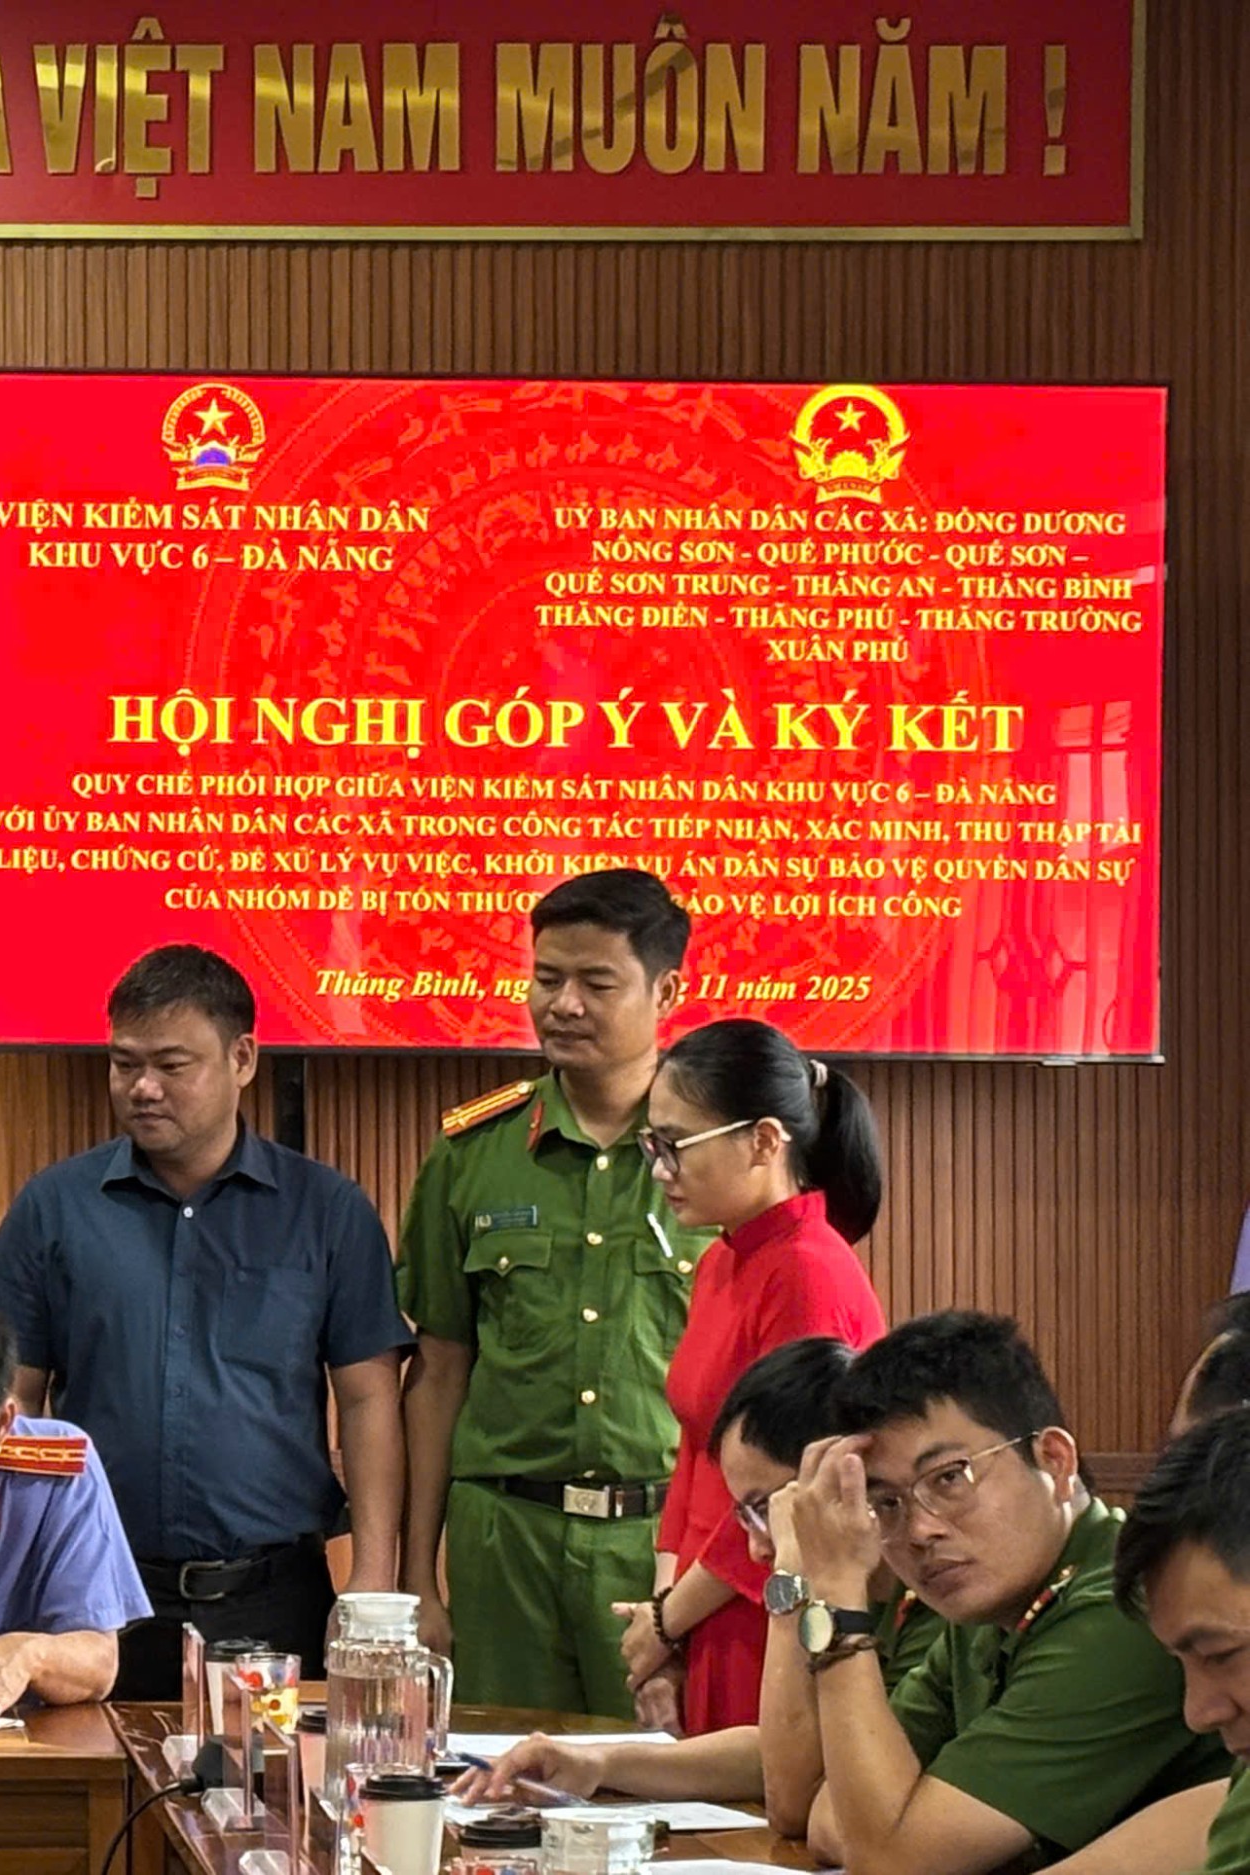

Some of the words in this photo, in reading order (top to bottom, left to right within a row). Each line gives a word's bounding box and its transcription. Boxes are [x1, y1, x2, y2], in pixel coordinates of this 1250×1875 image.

[33, 17, 225, 199] VIỆT
[254, 43, 460, 174] NAM
[496, 14, 766, 175] MUÔN
[797, 17, 1008, 176] NĂM
[1043, 44, 1068, 176] !
[182, 497, 247, 530] SÁT
[254, 499, 350, 531] NHÂN
[359, 500, 430, 533] DÂN
[599, 507, 657, 530] BAN
[663, 502, 743, 530] NHÂN
[750, 503, 808, 531] DÂN
[814, 504, 874, 532] CÁC
[880, 506, 927, 532] XÃ:
[1023, 510, 1126, 535] DƯƠNG
[29, 542, 101, 568] KHU
[110, 540, 183, 575] VỰC
[192, 544, 209, 569] 6
[242, 544, 288, 570] ĐÀ
[592, 533, 673, 562] NÔNG
[679, 540, 735, 563] SƠN
[1010, 544, 1067, 566] SƠN
[610, 571, 666, 594] SƠN
[671, 573, 771, 596] TRUNG
[792, 570, 892, 597] THĂNG
[896, 575, 936, 597] AN
[957, 572, 1057, 599] THĂNG
[1064, 572, 1132, 599] BÌNH
[535, 600, 635, 627] THĂNG
[729, 602, 831, 629] THĂNG
[837, 602, 894, 630] PHÚ
[915, 604, 1015, 631] THĂNG
[767, 633, 845, 662] XUÂN
[852, 634, 908, 663] PHÚ
[109, 688, 235, 757] HỘI
[252, 697, 426, 759] NGHỊ
[444, 685, 585, 748] GÓP
[598, 687, 645, 748] Ý
[660, 688, 754, 750] VÀ
[772, 688, 869, 751] KÝ
[887, 690, 1024, 753] KẾT
[72, 773, 130, 799] QUY
[274, 775, 331, 802] HỢP
[411, 774, 475, 803] VIỆN
[561, 773, 614, 800] SÁT
[619, 773, 695, 801] NHÂN
[702, 774, 758, 801] DÂN
[765, 780, 825, 803] KHU
[831, 780, 891, 808] VỰC
[895, 782, 911, 804] 6
[936, 777, 974, 804] ĐÀ
[86, 812, 140, 832] BAN
[148, 806, 224, 833] NHÂN
[231, 807, 287, 834] DÂN
[293, 808, 351, 835] CÁC
[357, 810, 395, 835] XÃ
[400, 815, 497, 836] TRONG
[503, 810, 582, 838] CÔNG
[587, 811, 644, 838] TÁC
[715, 816, 800, 845] NHẬN,
[805, 814, 862, 841] XÁC
[869, 820, 951, 844] MINH,
[955, 820, 1011, 842] THU
[1018, 818, 1092, 847] THẬP
[1094, 813, 1141, 844] TÀI
[320, 846, 356, 873] LÝ
[361, 852, 399, 878] VỤ
[405, 850, 478, 879] VIỆC,
[635, 855, 672, 880] VỤ
[679, 850, 717, 877] ÁN
[723, 849, 779, 878] DÂN
[786, 853, 825, 883] SỰ
[891, 855, 928, 885] VỆ
[1035, 853, 1090, 881] DÂN
[1097, 858, 1135, 887] SỰ
[165, 883, 221, 909] CỦA
[226, 883, 311, 910] NHÓM
[361, 890, 388, 916] BỊ
[456, 889, 546, 914] THƯƠ
[730, 891, 766, 920] VỆ
[773, 893, 821, 921] LỢI
[828, 889, 877, 917] ÍCH
[882, 889, 963, 918] CÔNG
[316, 969, 405, 1003] Thăng
[410, 970, 486, 1000] Bình,
[696, 974, 728, 999] 11
[735, 975, 797, 1000] năm
[804, 975, 872, 1001] 2025
